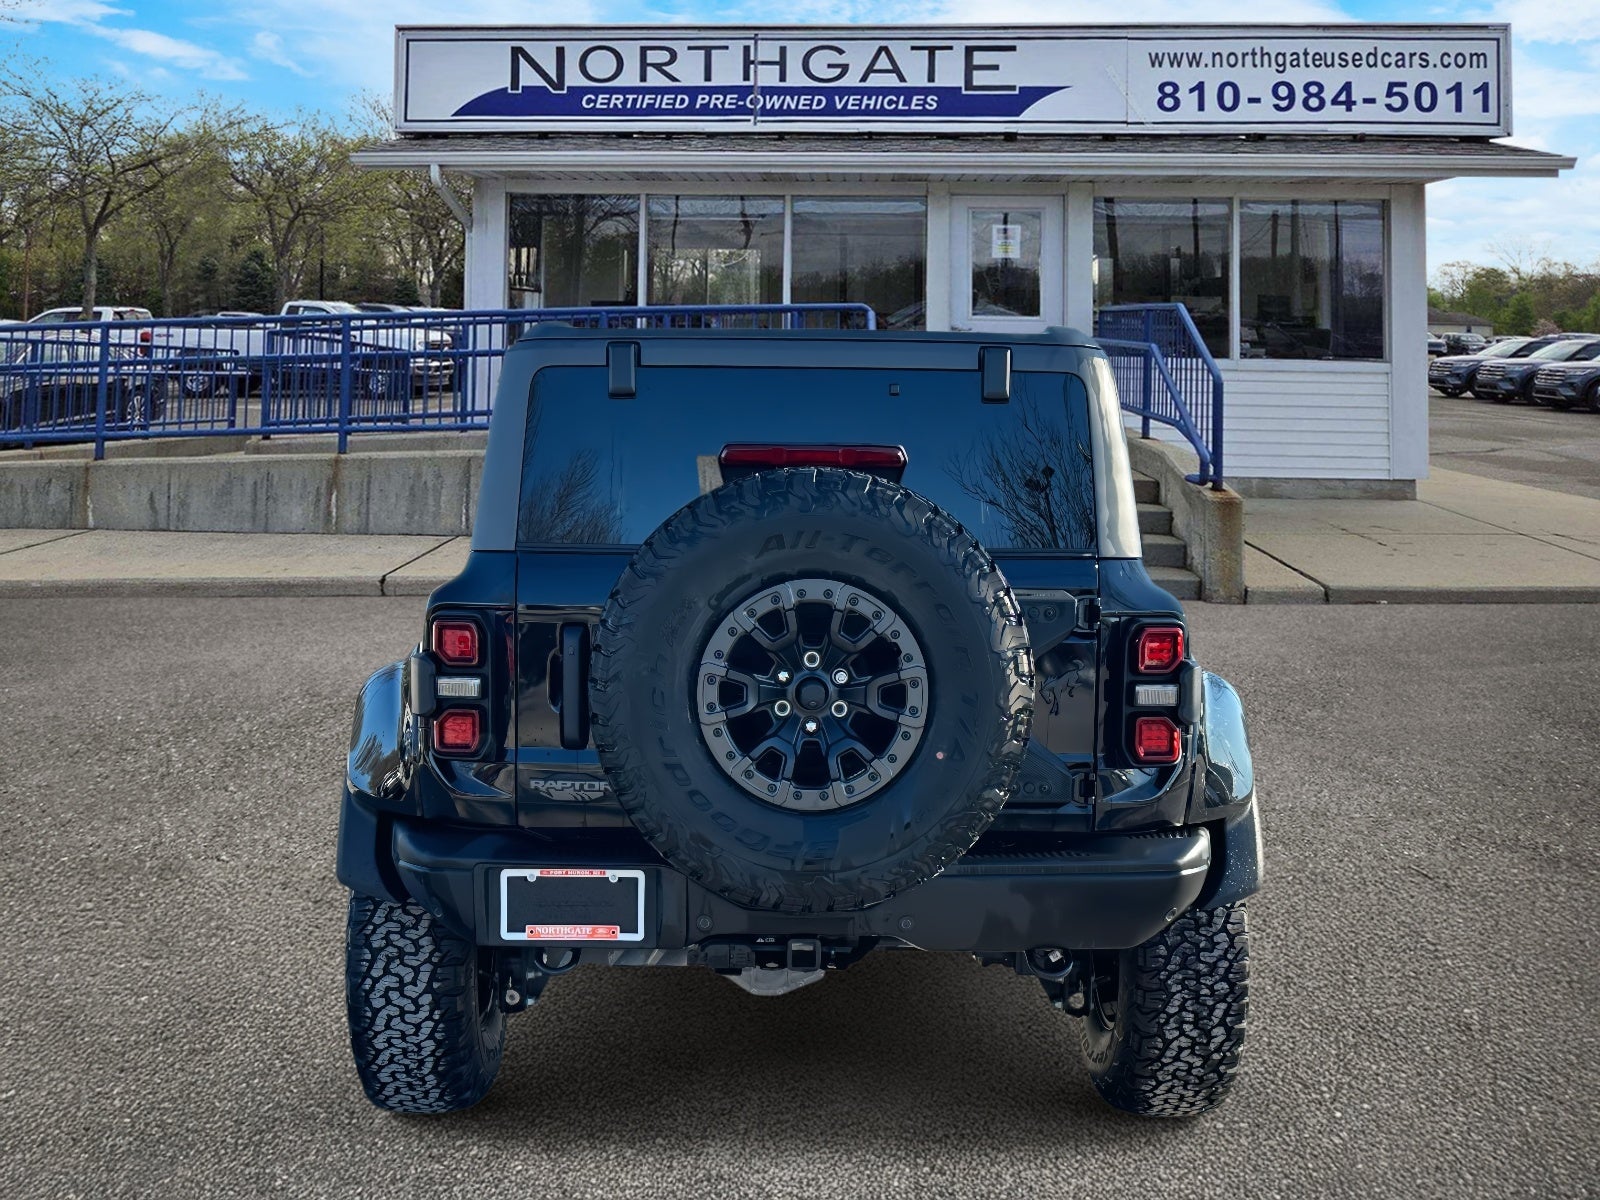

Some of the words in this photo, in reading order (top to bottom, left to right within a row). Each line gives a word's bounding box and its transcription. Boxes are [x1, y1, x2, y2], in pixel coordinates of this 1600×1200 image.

[509, 44, 1018, 92] NORTHGATE
[1148, 46, 1489, 73] www.northgateusedcars.com
[581, 93, 690, 110] CERTIFIED
[695, 94, 827, 111] PRE-OWNED
[834, 95, 939, 111] VEHICLES
[1156, 80, 1491, 113] 810-984-5011
[529, 779, 612, 792] RAPTOR
[535, 926, 592, 935] NORTHGATE
